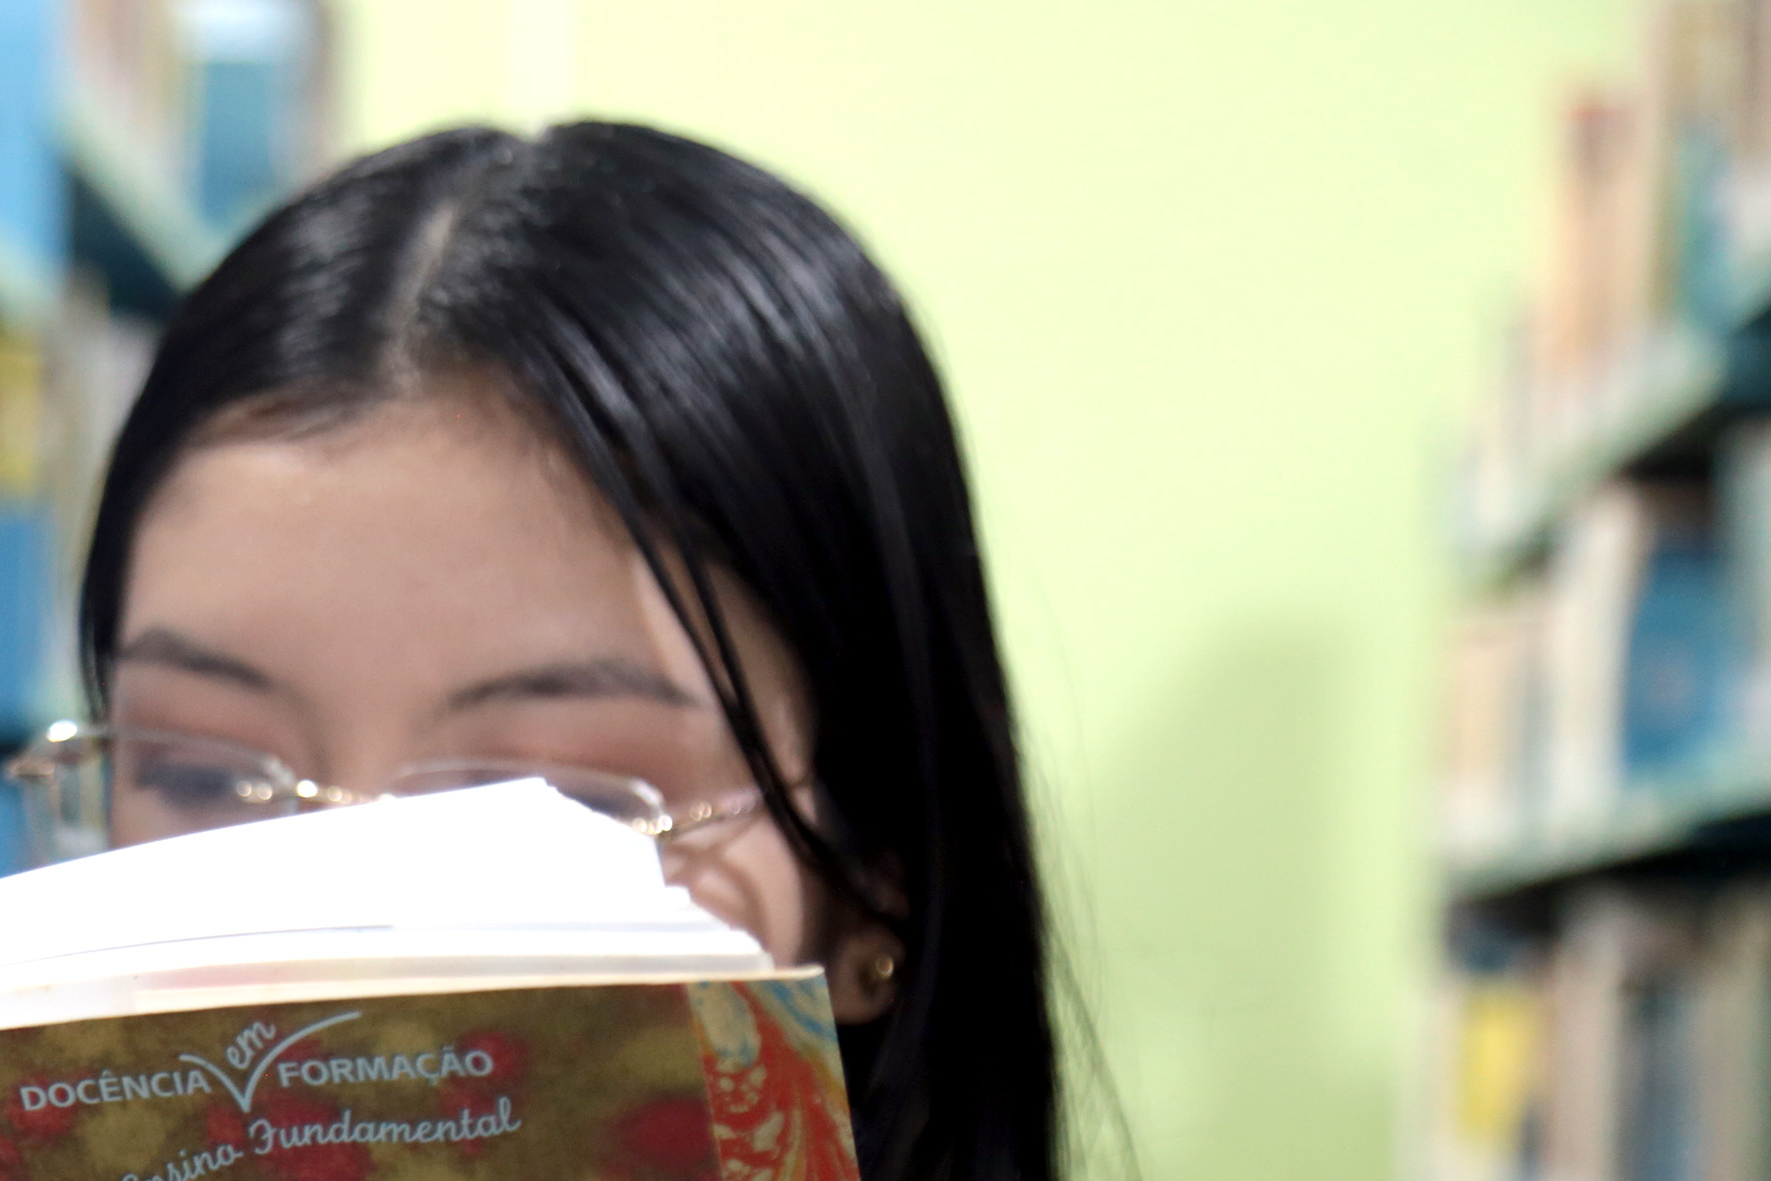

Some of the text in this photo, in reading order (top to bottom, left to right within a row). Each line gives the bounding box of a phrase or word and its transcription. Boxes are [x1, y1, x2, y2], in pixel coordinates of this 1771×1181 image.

[20, 1019, 494, 1112] DOCÊNCIA em FORMAÇÃO
[248, 1096, 522, 1155] Fundamental
